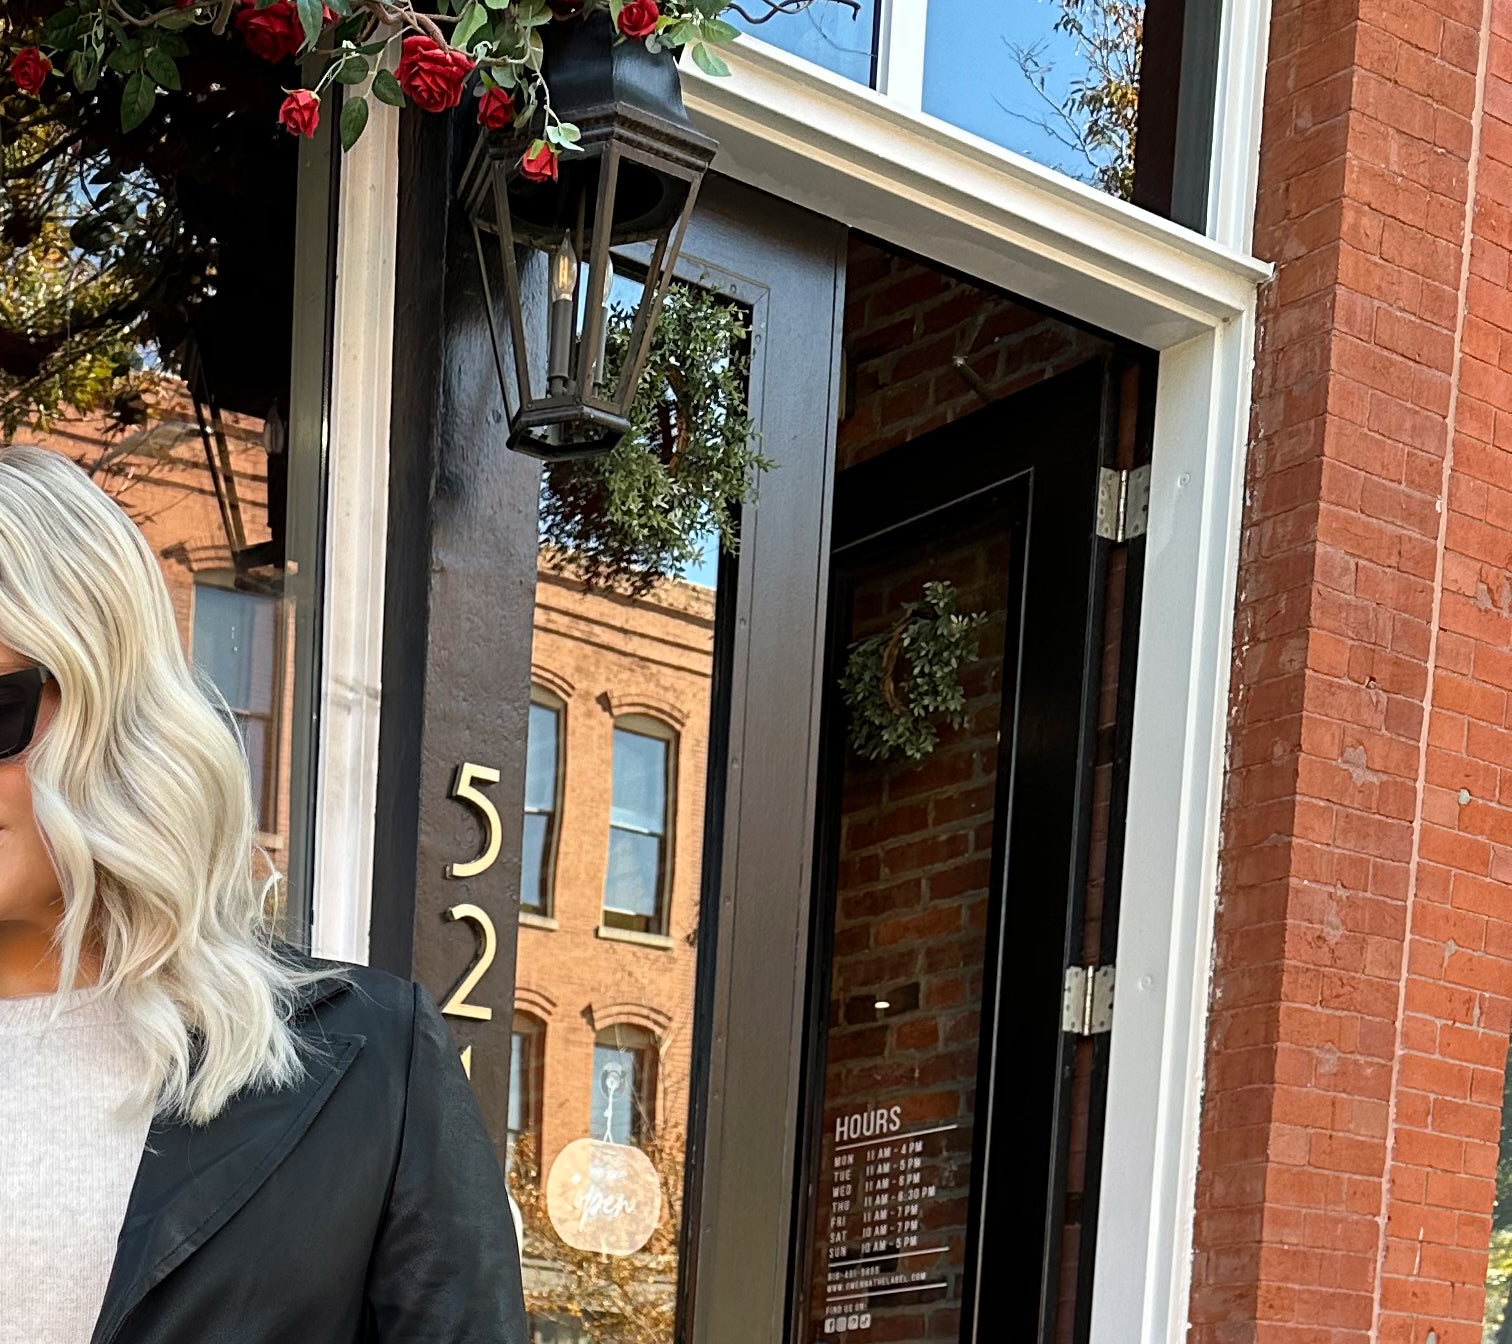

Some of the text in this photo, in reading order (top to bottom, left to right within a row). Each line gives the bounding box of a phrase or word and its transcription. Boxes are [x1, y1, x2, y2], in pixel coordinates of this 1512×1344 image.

[835, 1105, 902, 1142] HOURS
[834, 1153, 854, 1168] MON
[866, 1149, 875, 1162] 11
[877, 1146, 891, 1159] AM
[900, 1142, 906, 1155] 4
[909, 1140, 922, 1154] PM
[833, 1168, 851, 1183] TUE
[866, 1164, 874, 1177] 11
[876, 1161, 890, 1175] AM
[907, 1156, 921, 1169] PM
[832, 1185, 852, 1198] WED
[864, 1181, 873, 1193] 11
[875, 1178, 889, 1190] AM
[906, 1172, 920, 1185] PM
[573, 1184, 636, 1232] open
[831, 1200, 850, 1213] THU
[863, 1196, 872, 1208] 11
[874, 1193, 888, 1206] AM
[921, 1185, 935, 1198] PM
[830, 1215, 846, 1229] FRI
[863, 1211, 871, 1223] 11
[873, 1208, 887, 1222] AM
[897, 1205, 902, 1217] 7
[904, 1203, 918, 1217] PM
[830, 1230, 847, 1244] SAT
[862, 1227, 872, 1239] 10
[873, 1224, 887, 1237] AM
[897, 1221, 902, 1234] 7
[904, 1219, 918, 1233] PM
[828, 1246, 846, 1259] SUN
[861, 1242, 871, 1255] 10
[873, 1239, 886, 1253] AM
[903, 1235, 917, 1248] PM
